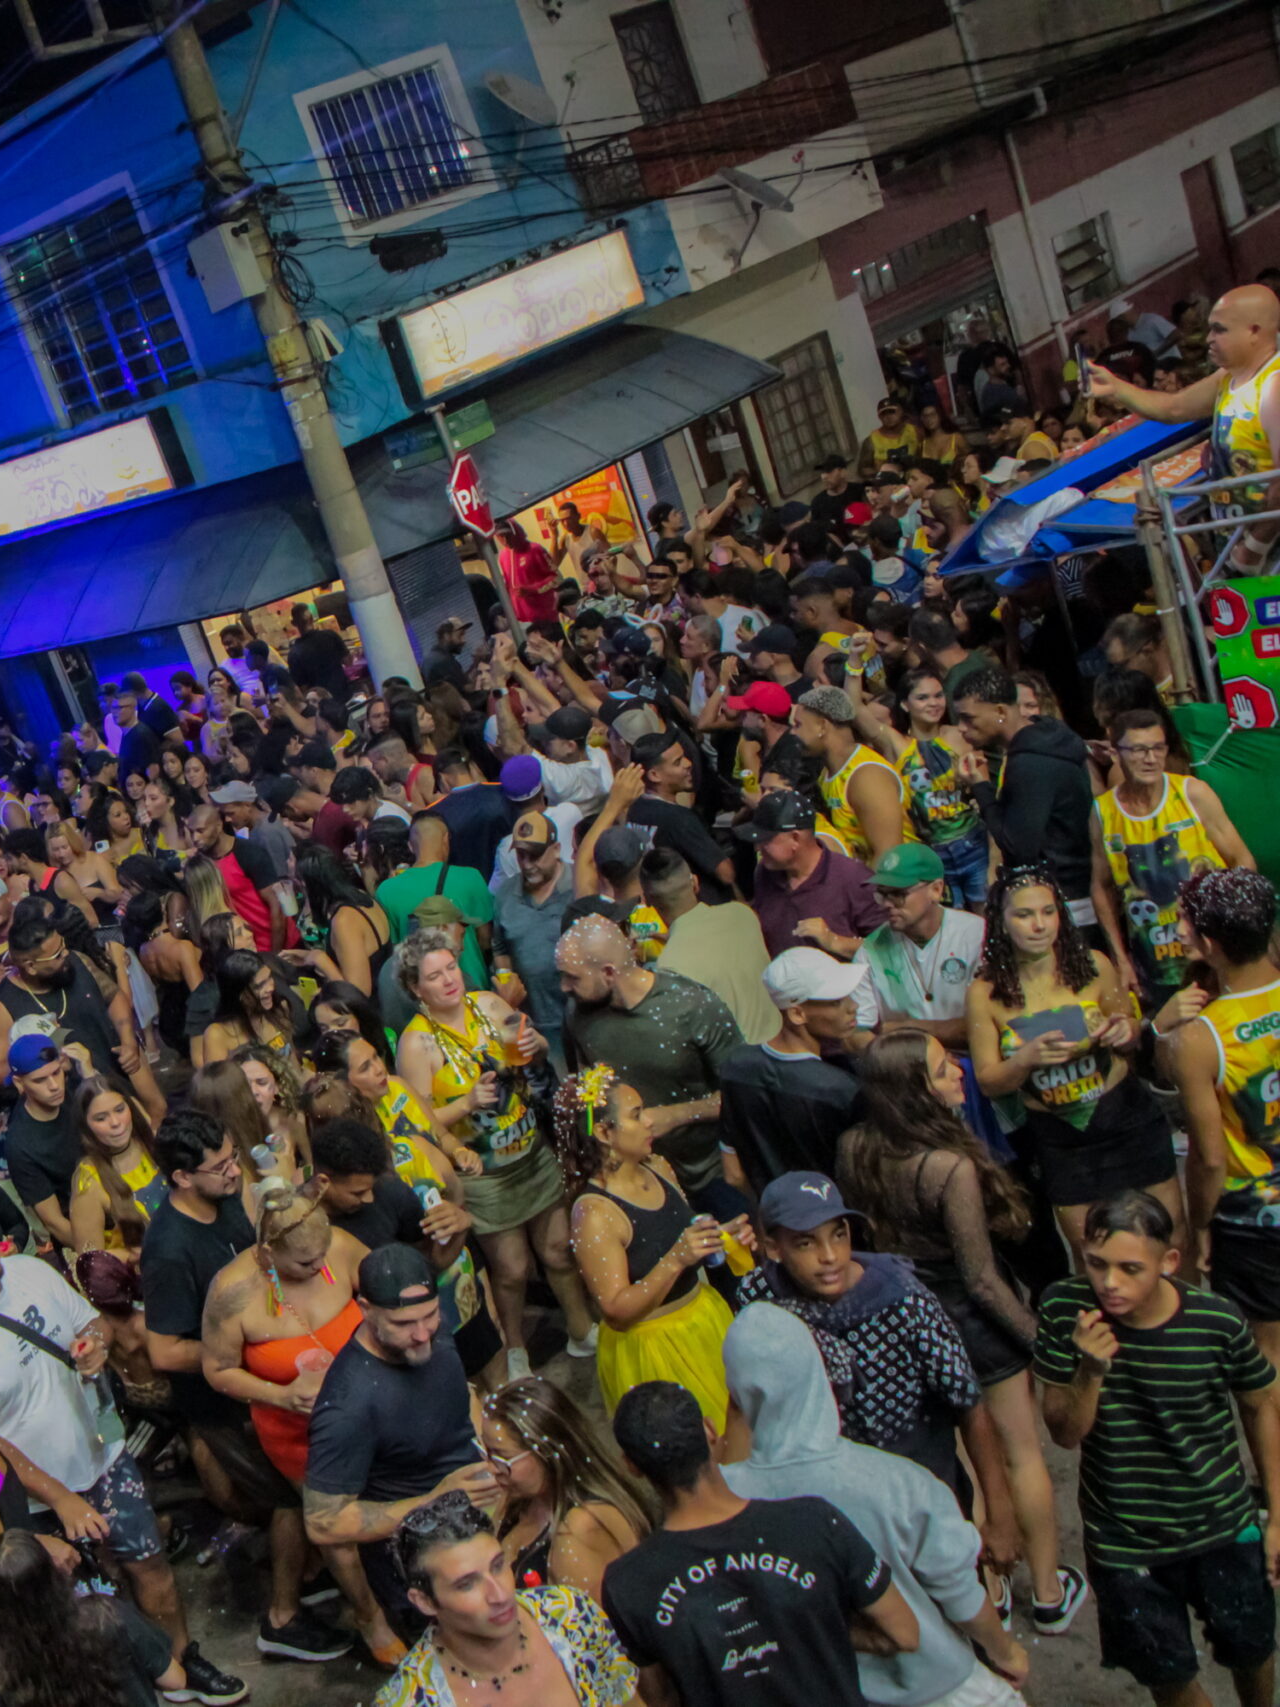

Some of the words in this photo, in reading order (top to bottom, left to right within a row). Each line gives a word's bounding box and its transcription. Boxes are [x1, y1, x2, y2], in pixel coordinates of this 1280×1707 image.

[1031, 1054, 1097, 1091] GATO
[1041, 1071, 1105, 1105] PRETO
[489, 1106, 537, 1150] GATO
[655, 1576, 688, 1627] CITY
[687, 1557, 718, 1584] OF
[724, 1552, 817, 1590] ANGELS
